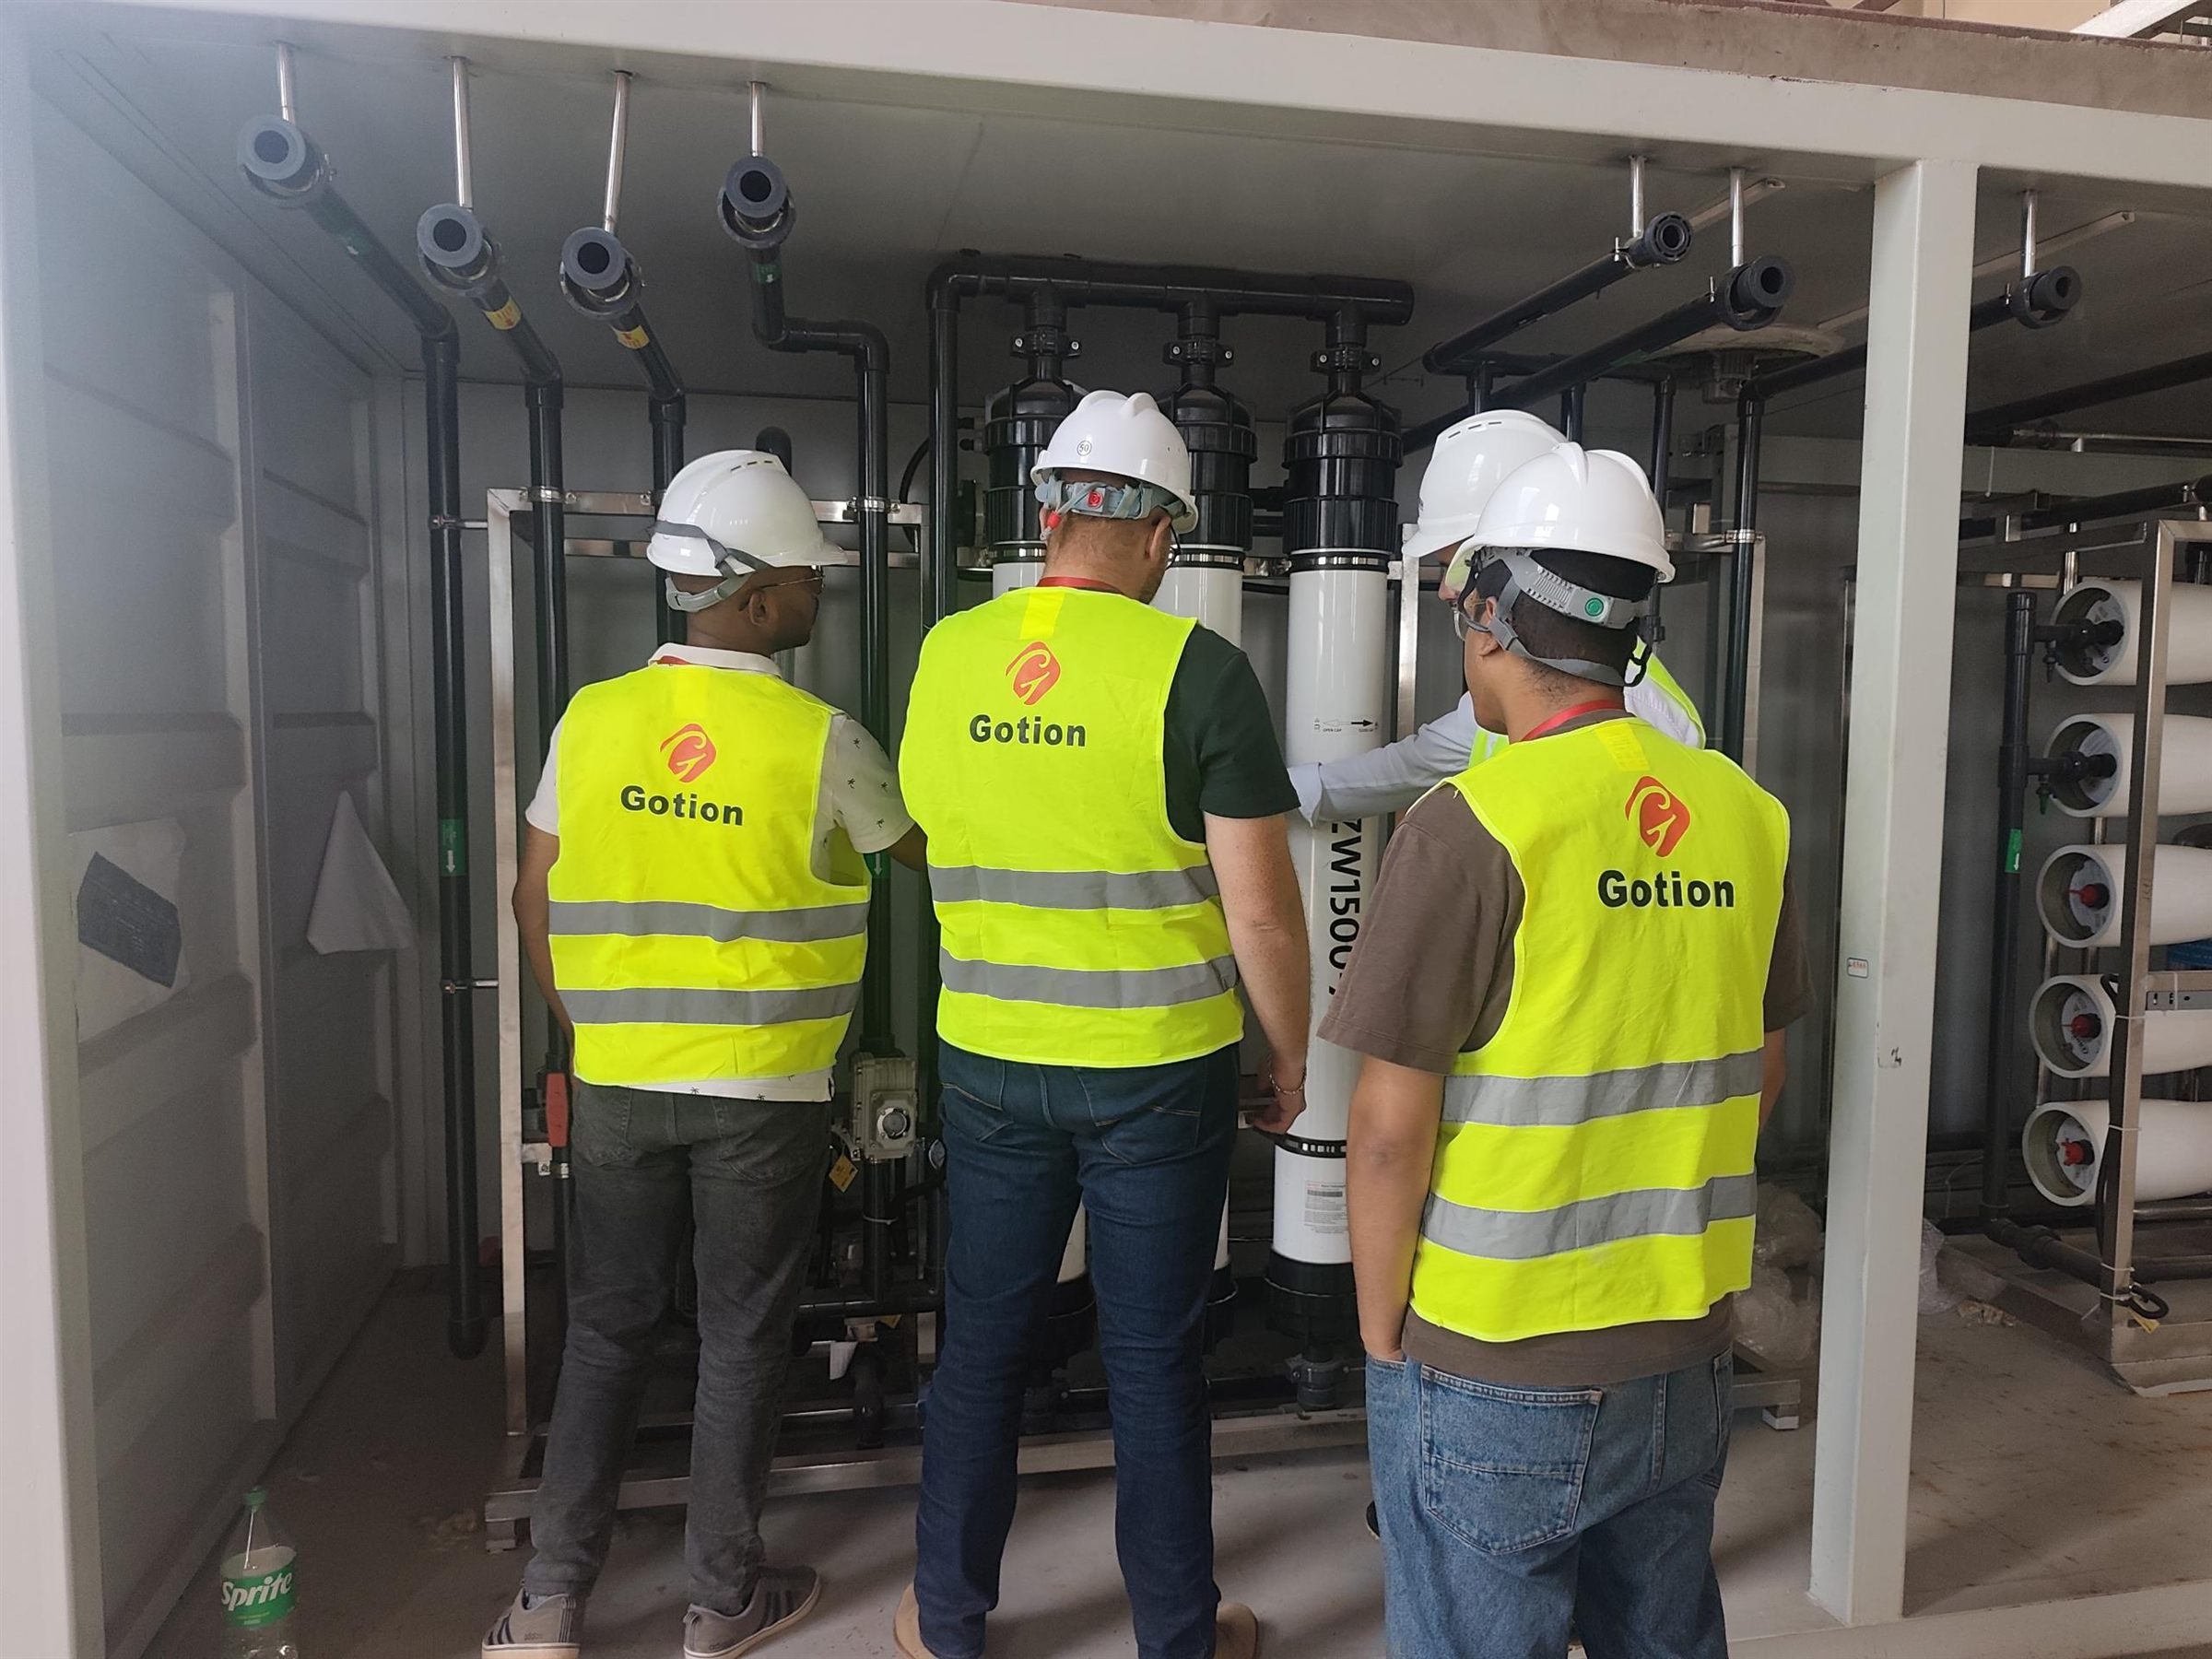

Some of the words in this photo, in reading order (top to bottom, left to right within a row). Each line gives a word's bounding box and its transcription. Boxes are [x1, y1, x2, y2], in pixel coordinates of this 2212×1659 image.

[970, 714, 1086, 747] Gotion
[620, 785, 743, 826] Gotion
[1597, 869, 1735, 908] Gotion
[221, 1572, 293, 1612] Sprite
